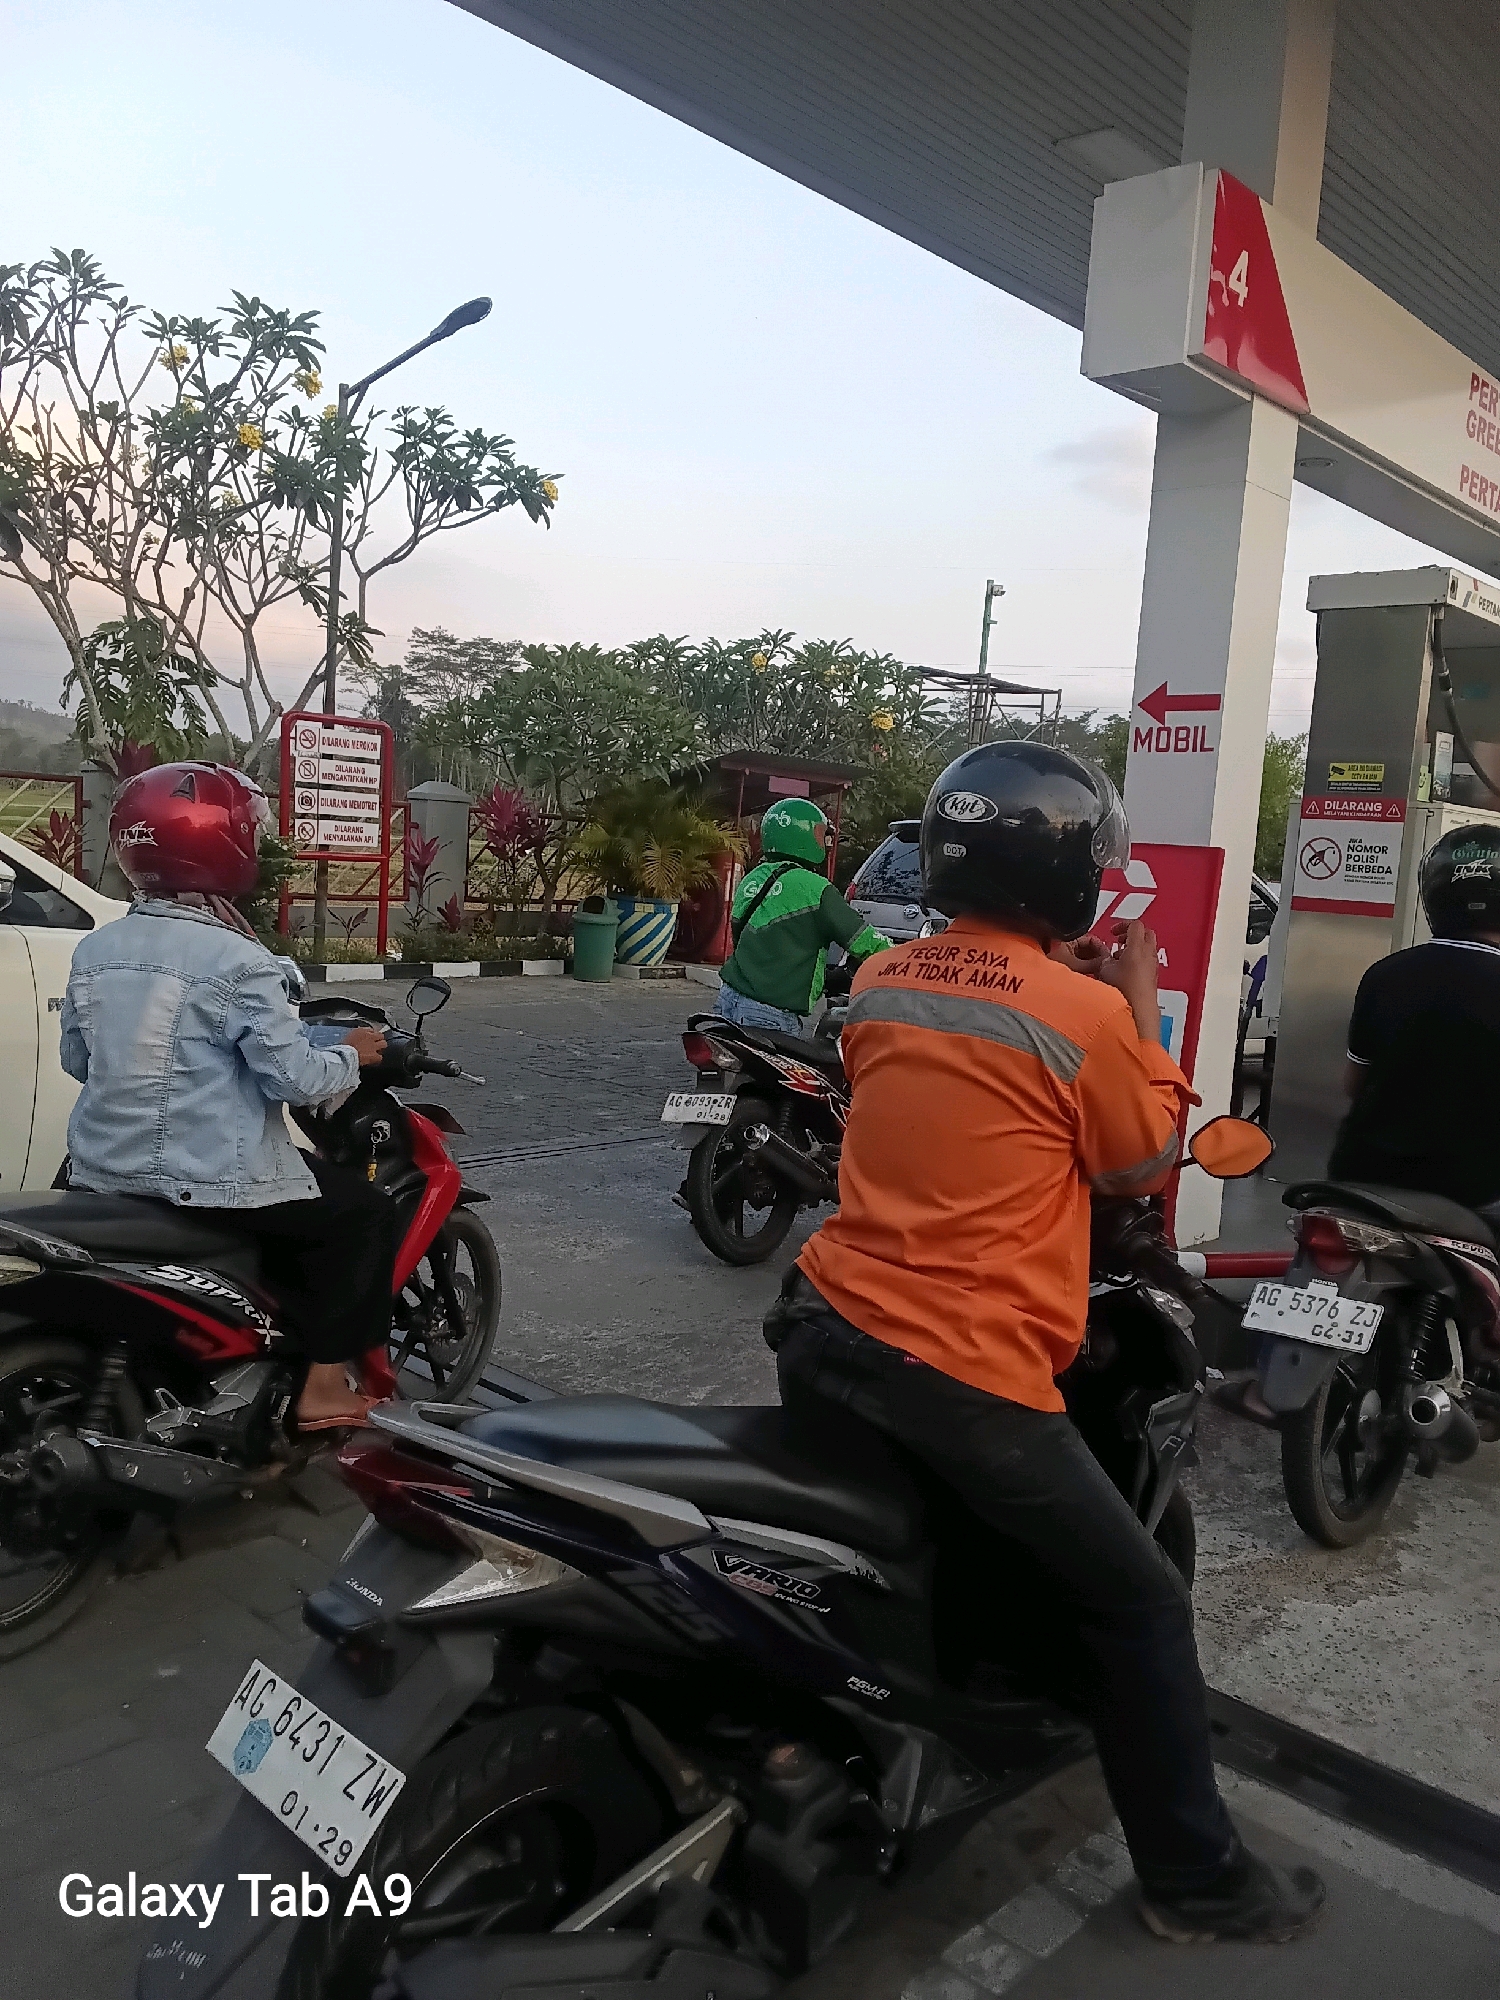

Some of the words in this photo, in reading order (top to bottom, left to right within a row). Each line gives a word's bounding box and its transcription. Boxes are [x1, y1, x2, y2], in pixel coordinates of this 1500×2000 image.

[1229, 249, 1249, 308] 4
[1469, 371, 1500, 418] PER
[322, 737, 350, 748] DILARANG
[1133, 725, 1215, 753] MOBIL
[335, 764, 366, 774] DILARANG
[321, 798, 348, 809] DILARANG
[349, 800, 377, 811] MEMOTRET
[1324, 800, 1383, 812] DILARANG
[119, 820, 159, 851] INK
[323, 832, 363, 843] MENYALAKAN
[363, 836, 374, 844] API
[334, 824, 364, 834] DILARANG
[1346, 844, 1389, 855] NOMOR
[1346, 854, 1379, 864] POLISI
[1345, 863, 1393, 875] BERBEDA
[1451, 859, 1494, 883] INK
[907, 946, 960, 962] TEGUR
[963, 948, 1010, 971] SAYA
[877, 961, 911, 977] JIKA
[915, 962, 964, 985] TIDAK
[965, 968, 1024, 994] AMAN
[668, 1096, 683, 1107] AG
[146, 1264, 264, 1325] SUPRA
[1311, 1278, 1338, 1288] HONDA
[1255, 1285, 1282, 1306] AG
[1289, 1291, 1340, 1319] 5376
[1349, 1305, 1378, 1328] ZJ
[711, 1550, 821, 1599] VARIO
[345, 1577, 383, 1607] HONDA
[234, 1668, 277, 1718] AG
[273, 1696, 345, 1776] 6431
[342, 1752, 399, 1819] ZW
